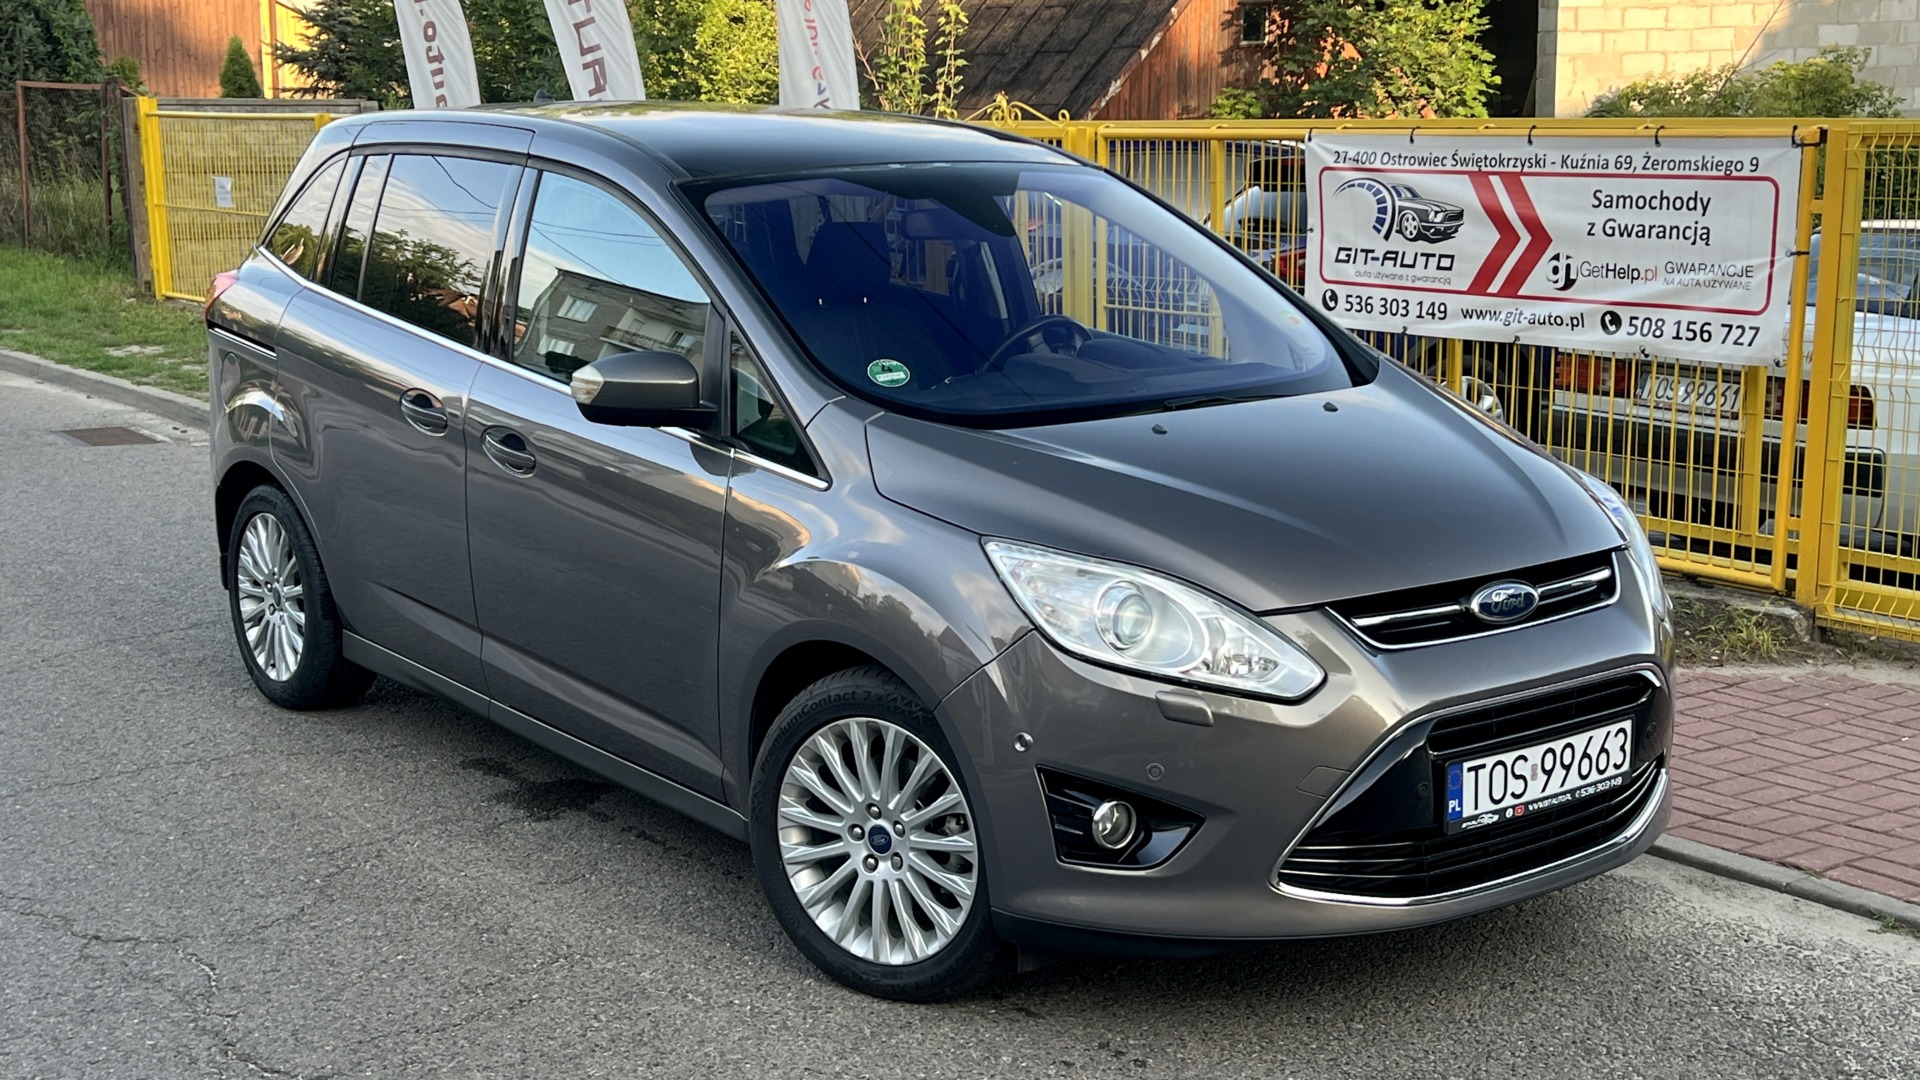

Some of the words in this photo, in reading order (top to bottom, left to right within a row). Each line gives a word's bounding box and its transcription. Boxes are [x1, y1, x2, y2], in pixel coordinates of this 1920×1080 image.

[1333, 150, 1377, 165] 27-400
[1380, 152, 1448, 167] Ostrowiec
[1451, 149, 1547, 172] Świętokrzyski
[1560, 153, 1610, 170] Kuźnia
[1614, 155, 1637, 173] 69,
[1641, 152, 1745, 176] Żeromskiego
[1749, 156, 1760, 173] 9
[1591, 189, 1711, 217] Samochody
[1586, 221, 1596, 237] z
[1602, 218, 1711, 247] Gwarancją
[1334, 246, 1456, 272] GIT-AUTO
[1664, 261, 1755, 278] GWARANCJE
[1580, 260, 1658, 285] GetHelp.pl
[1662, 277, 1675, 286] NA
[1676, 278, 1702, 288] AUTA
[1344, 294, 1374, 315] 536
[1378, 297, 1410, 318] 303
[1415, 300, 1448, 321] 149
[1460, 307, 1585, 331] www.git-auto.pl
[1625, 316, 1666, 339] 508
[1671, 319, 1713, 343] 156
[1719, 323, 1761, 348] 727
[1490, 588, 1525, 613] Ford
[1466, 754, 1529, 811] TOS
[1540, 727, 1628, 793] 99663
[1448, 799, 1461, 814] PL
